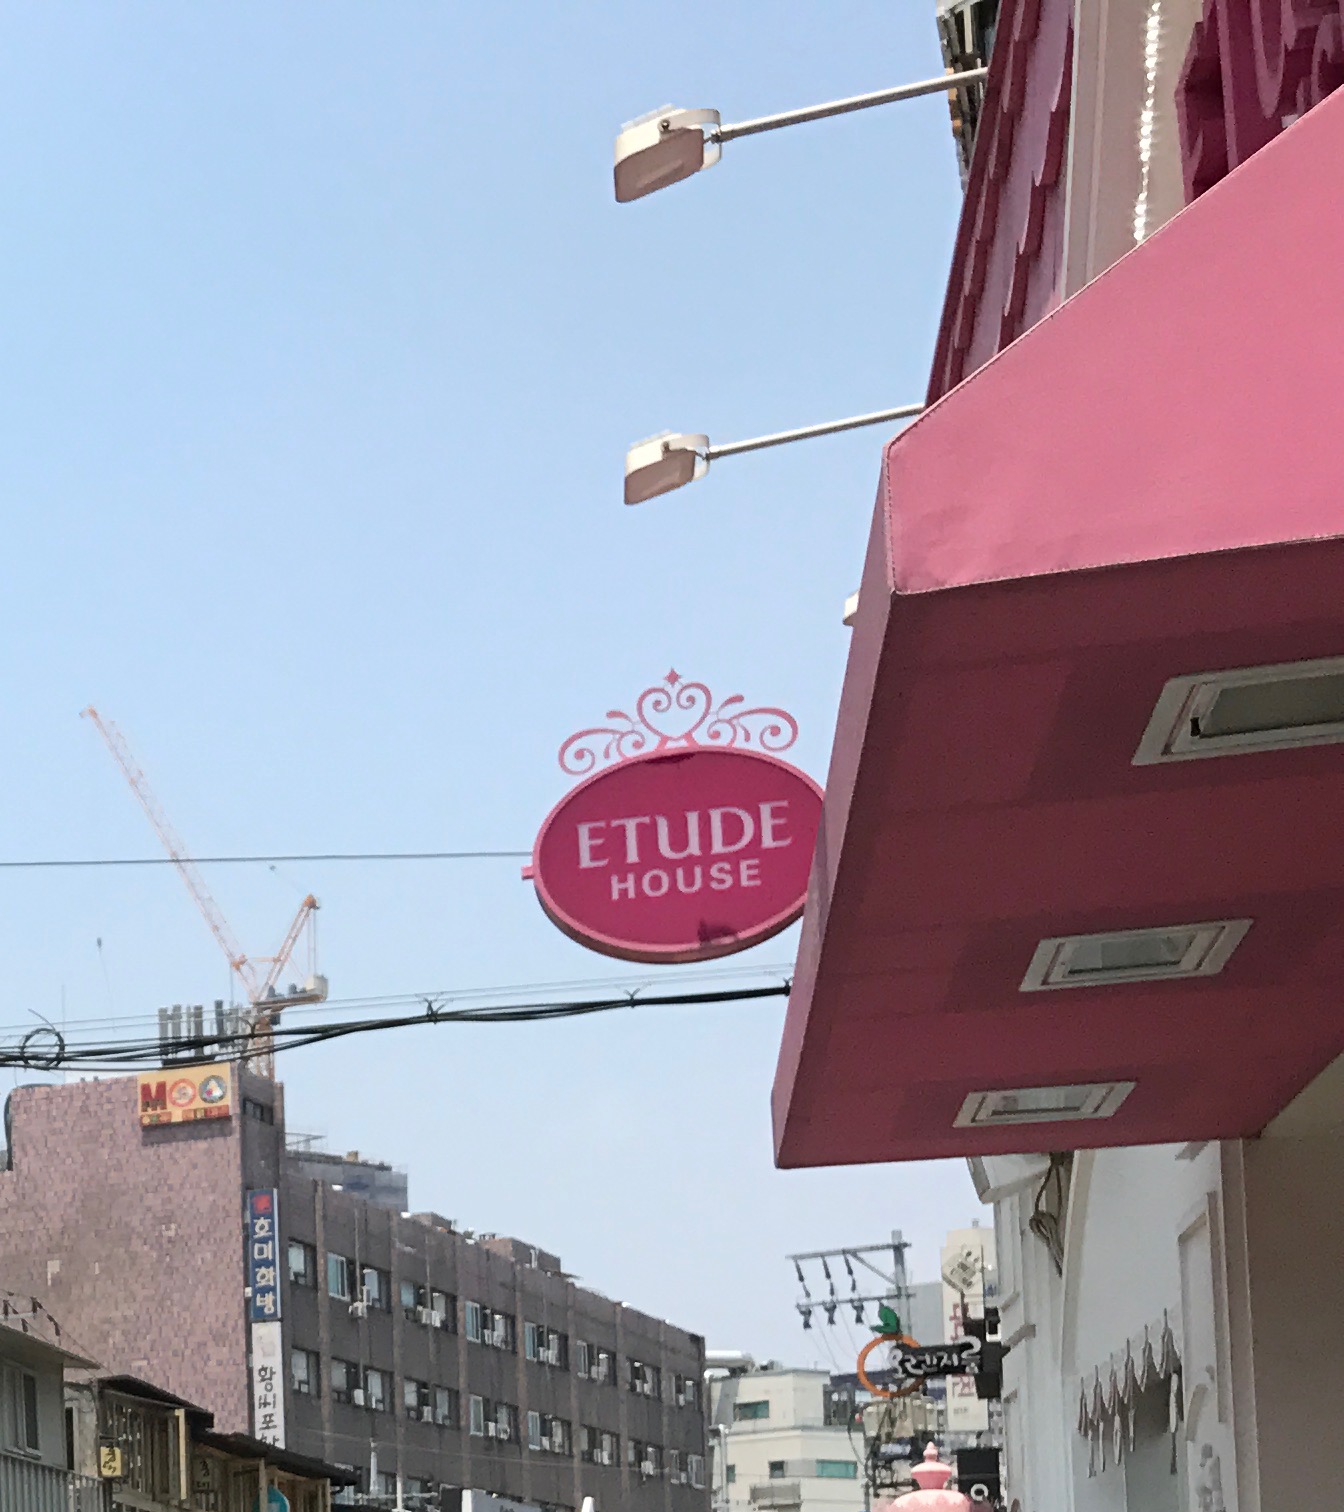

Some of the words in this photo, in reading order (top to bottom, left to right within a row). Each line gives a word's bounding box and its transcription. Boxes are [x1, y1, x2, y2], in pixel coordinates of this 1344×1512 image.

[576, 799, 793, 869] ETUDE
[611, 857, 763, 901] HOUSE
[252, 1216, 276, 1315] 호미화방
